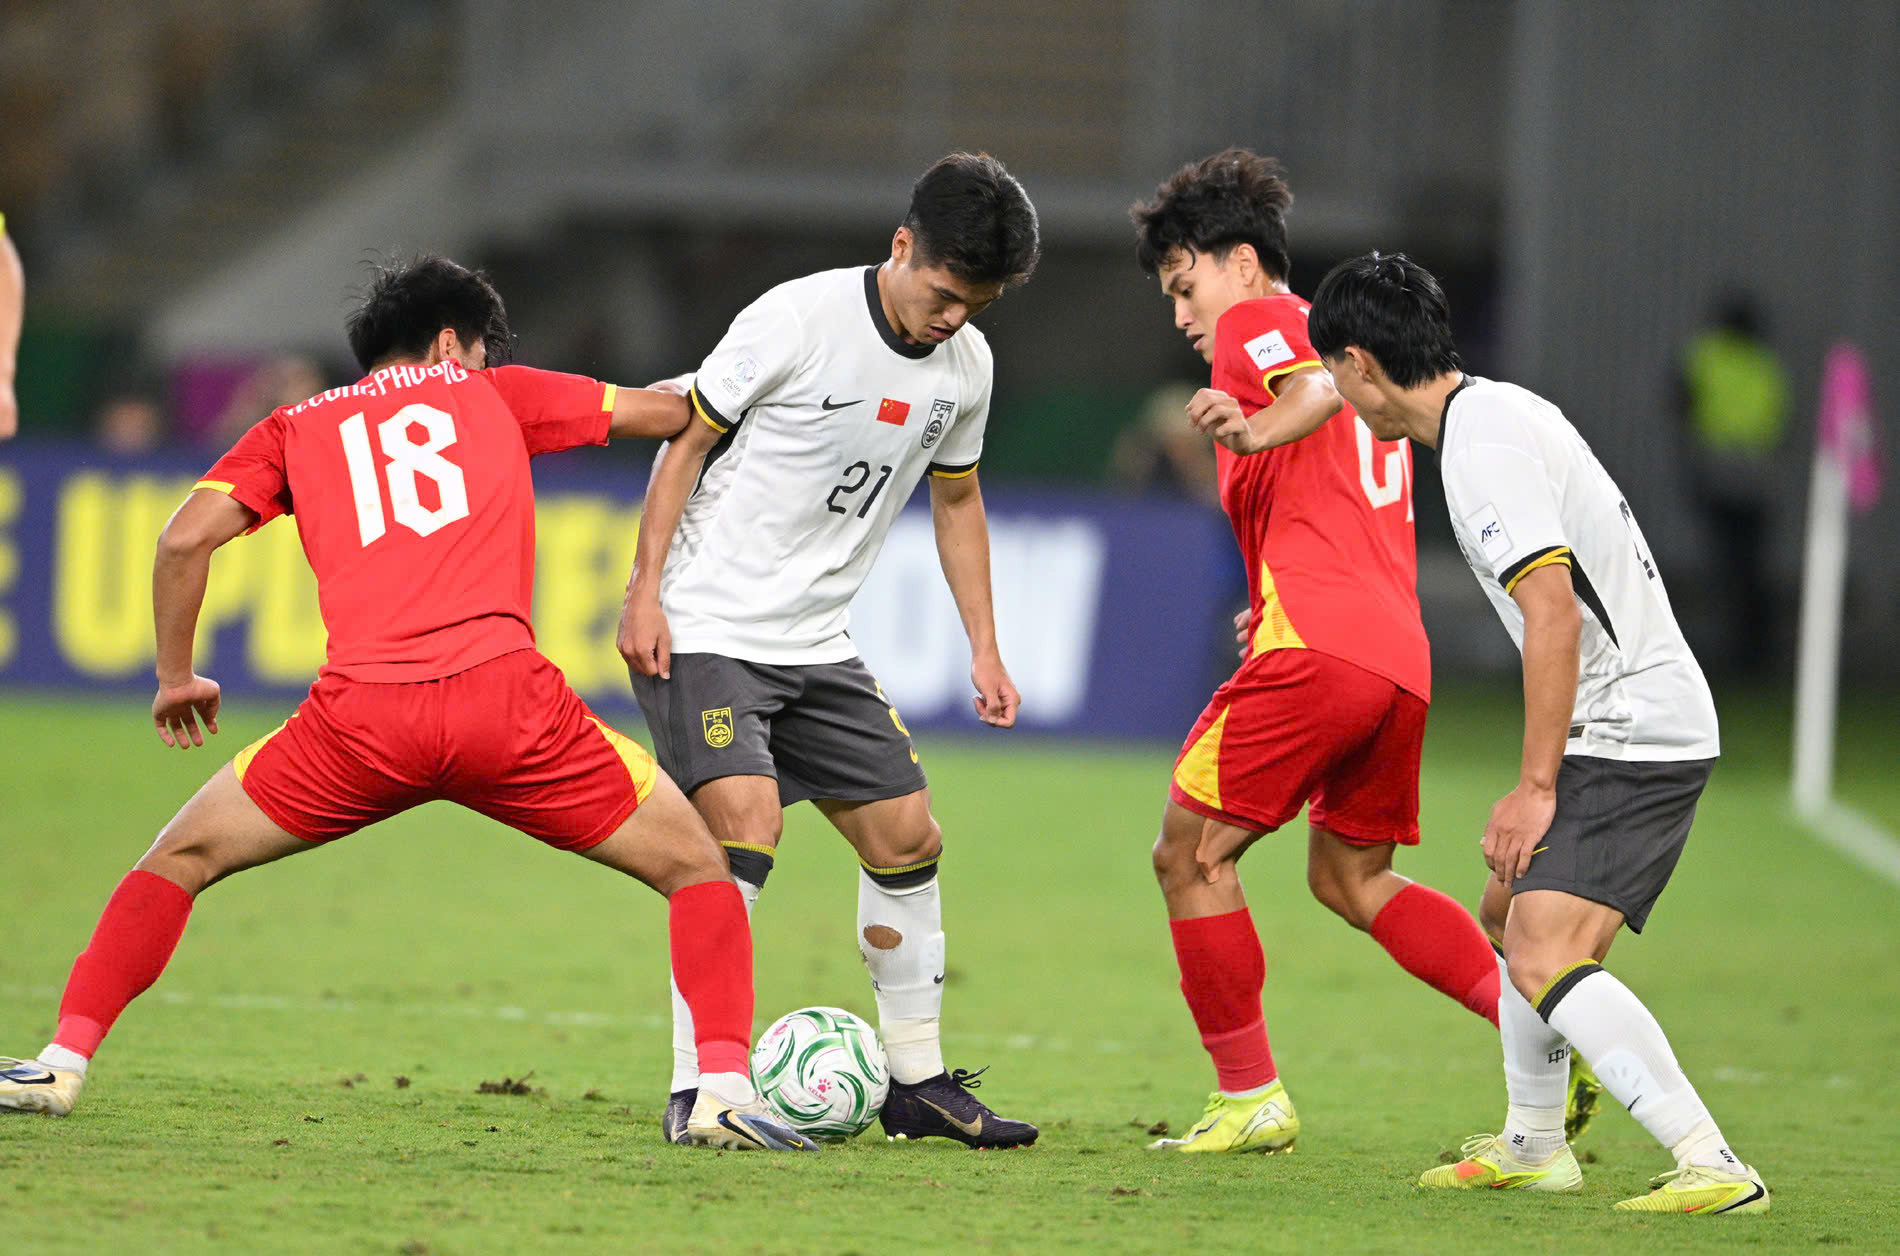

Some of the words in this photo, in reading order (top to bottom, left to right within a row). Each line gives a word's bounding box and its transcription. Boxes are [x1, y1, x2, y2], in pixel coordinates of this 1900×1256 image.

[1257, 343, 1282, 357] AFC
[339, 403, 471, 549] 18
[826, 460, 893, 519] 21
[1481, 520, 1501, 543] AFC
[705, 710, 729, 720] CFA
